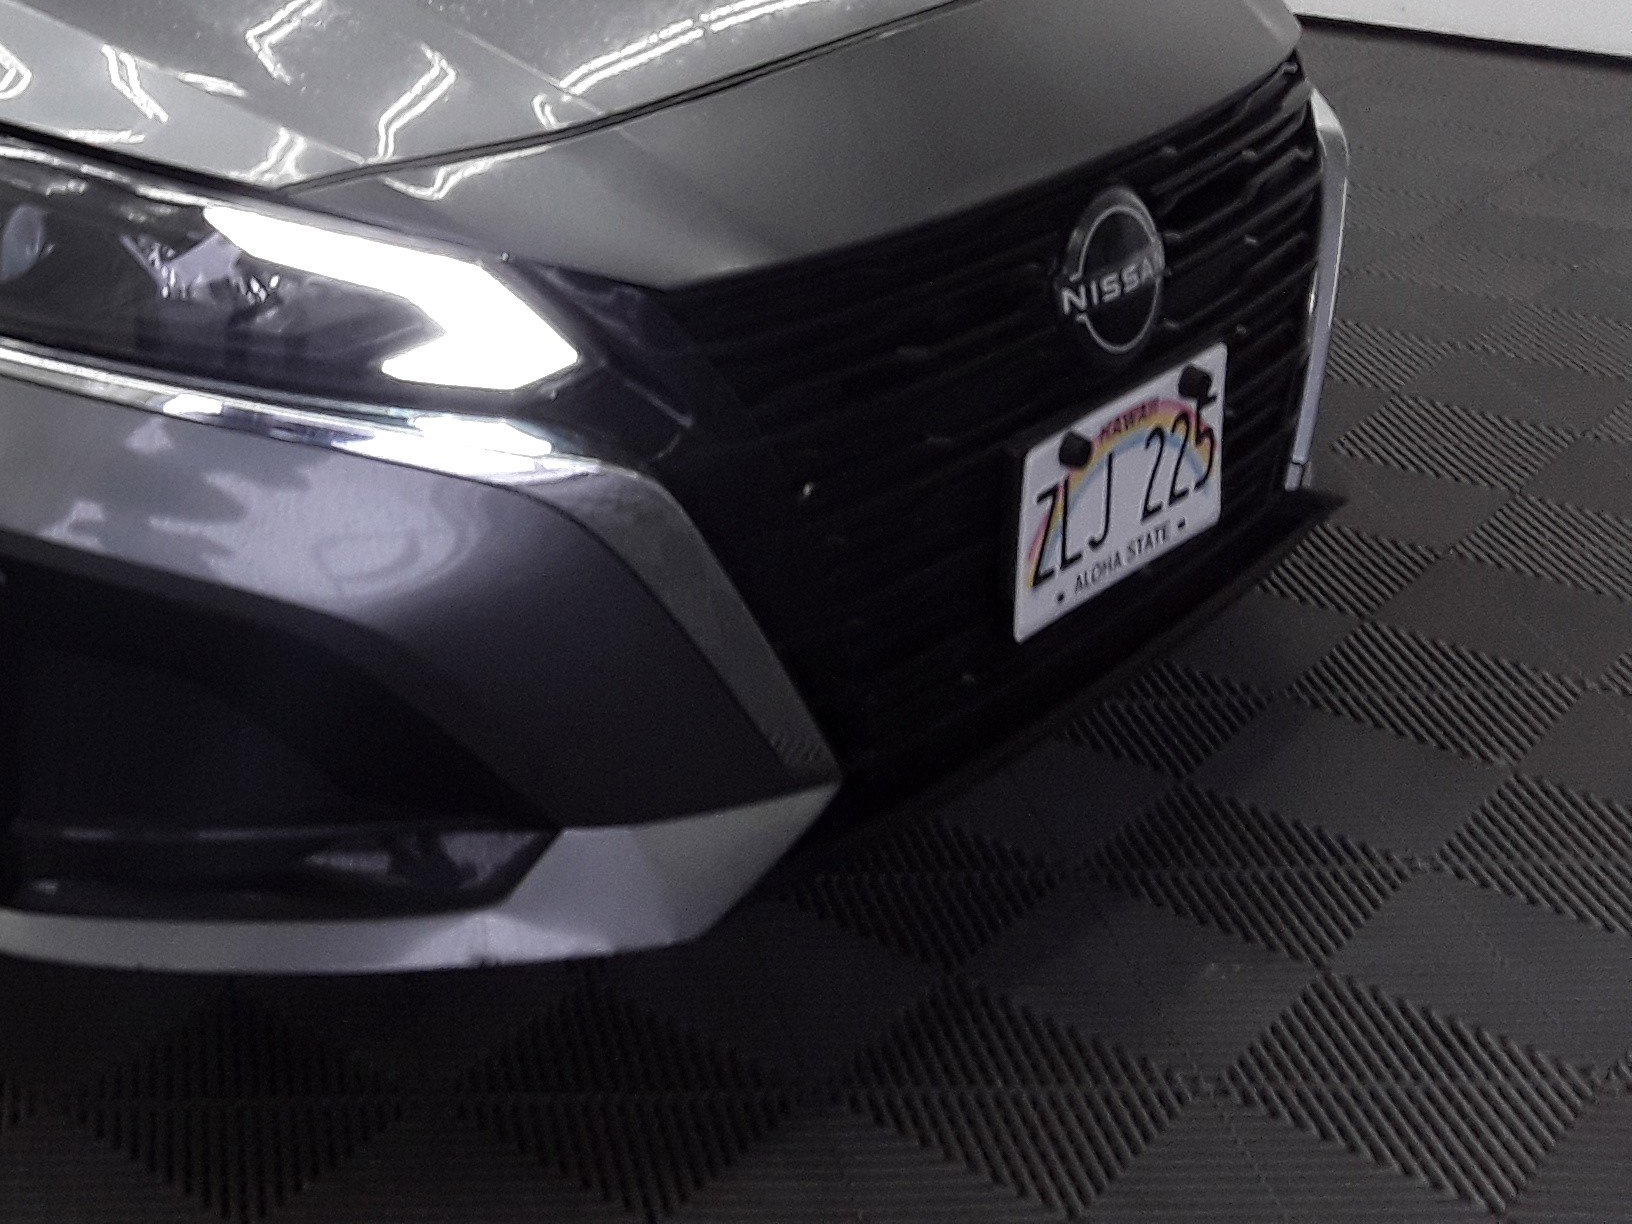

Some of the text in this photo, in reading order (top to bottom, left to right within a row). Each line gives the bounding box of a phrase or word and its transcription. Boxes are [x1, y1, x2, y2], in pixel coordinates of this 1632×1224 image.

[1030, 394, 1217, 589] ZLJ 225
[1074, 520, 1171, 595] ALOHA STATE
